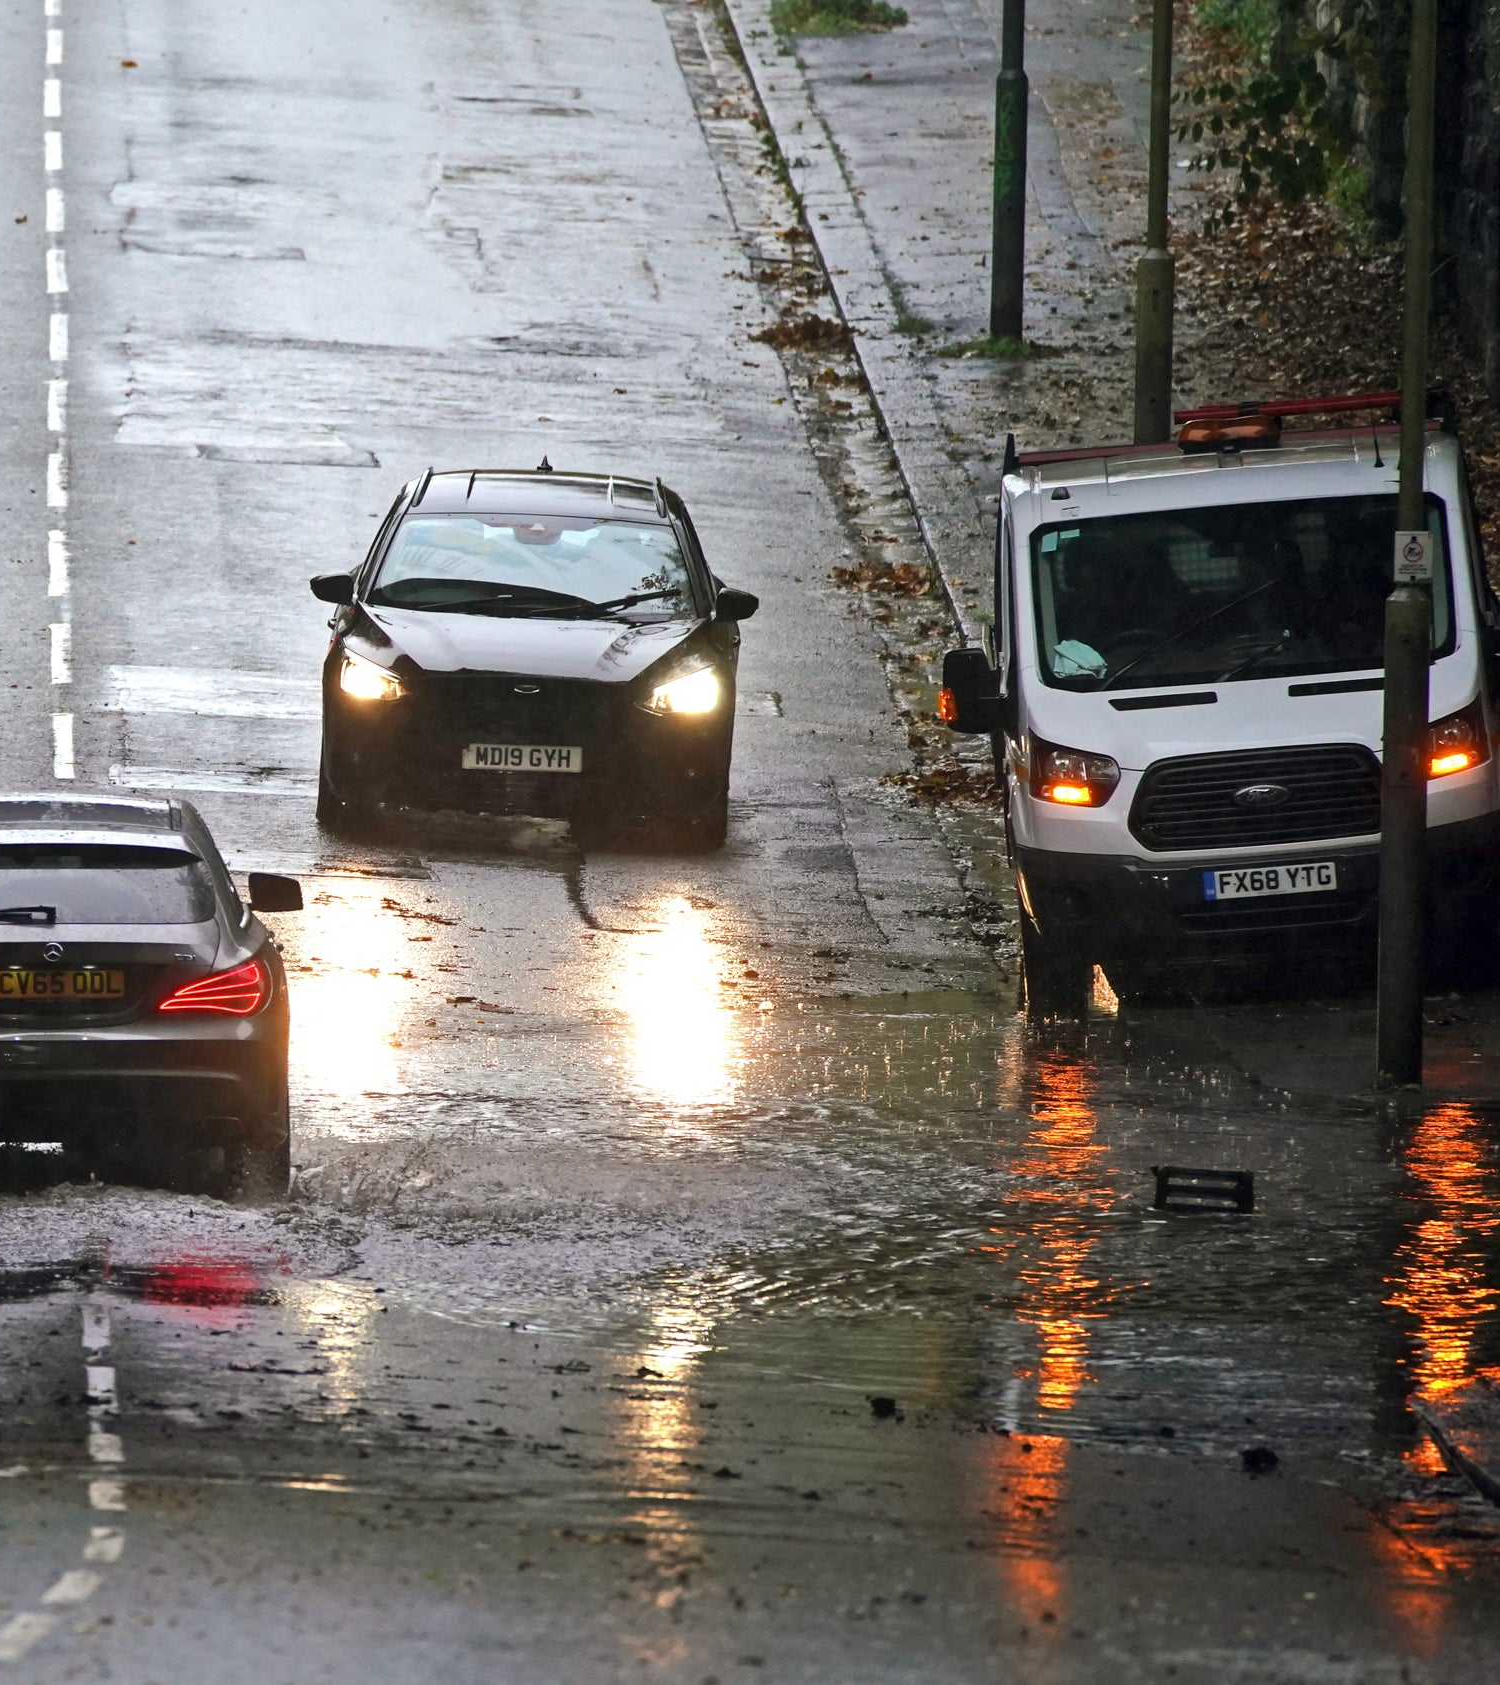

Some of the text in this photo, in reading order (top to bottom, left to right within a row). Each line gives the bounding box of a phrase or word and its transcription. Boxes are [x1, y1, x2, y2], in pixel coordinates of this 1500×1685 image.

[475, 746, 571, 769] MD19 GYH
[1218, 864, 1332, 894] FX68 YTG
[0, 972, 120, 995] CV65 ODL
